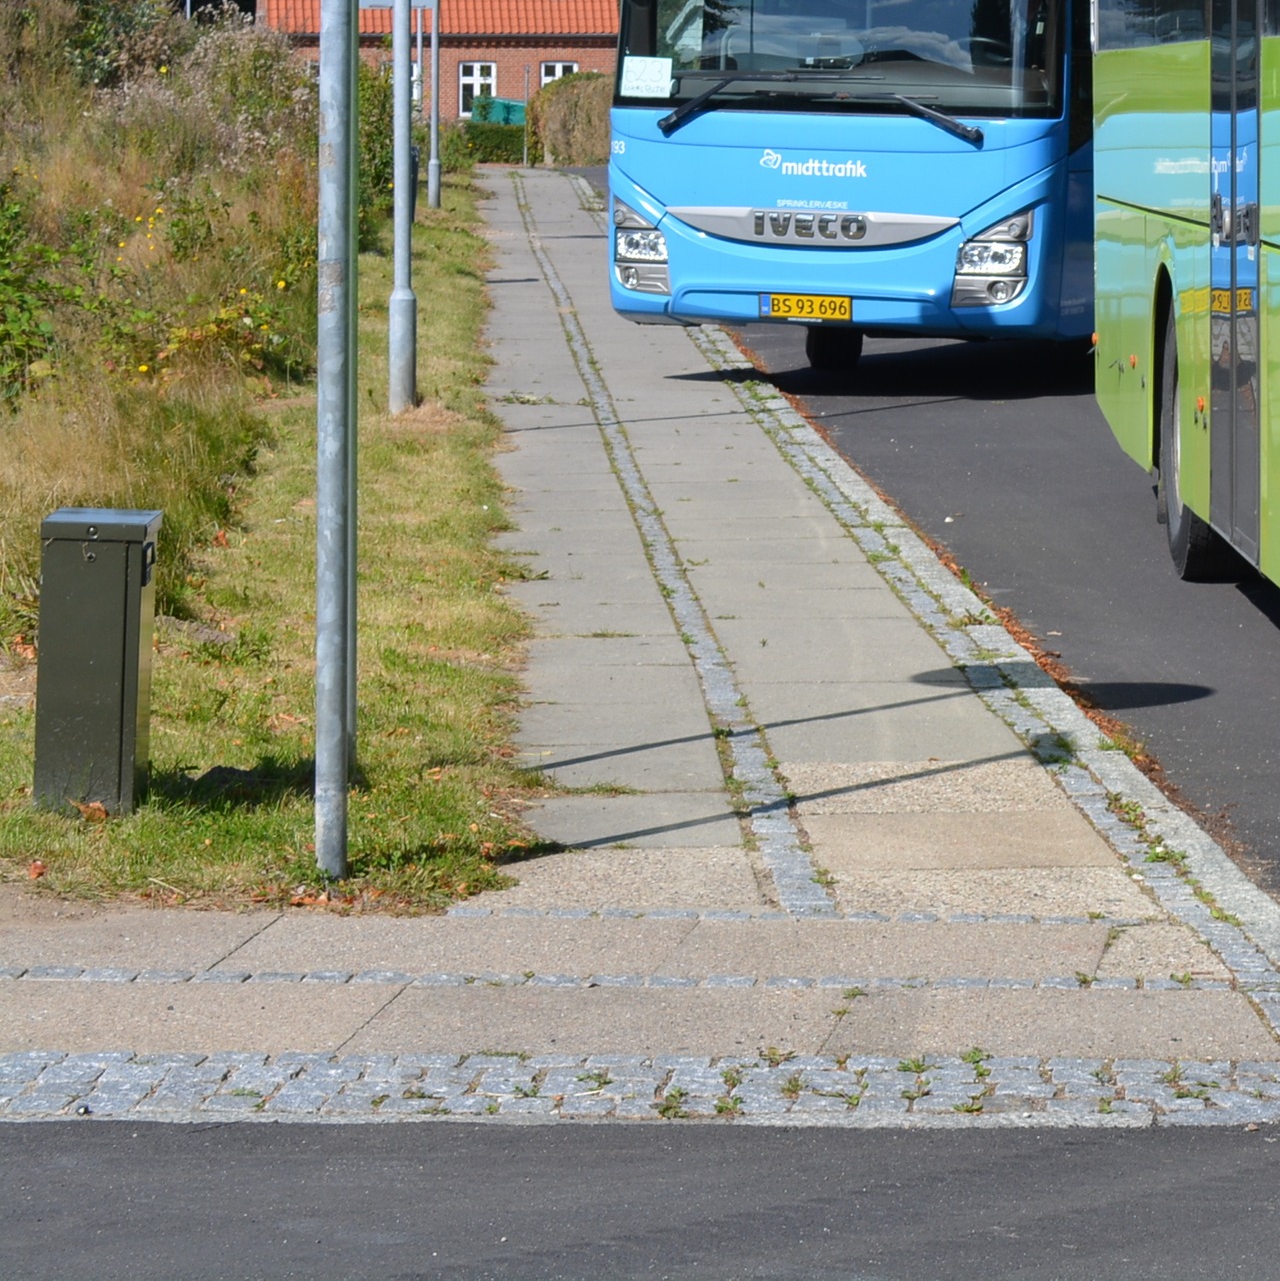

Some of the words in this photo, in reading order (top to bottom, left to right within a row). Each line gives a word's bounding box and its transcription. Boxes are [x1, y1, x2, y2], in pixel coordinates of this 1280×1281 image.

[611, 140, 625, 154] 93
[781, 158, 867, 177] midttrafik
[776, 199, 848, 209] SPRINKLERVÆSKE
[753, 210, 867, 240] IVECO
[771, 297, 792, 313] BS
[796, 298, 814, 314] 93
[819, 299, 847, 316] 696
